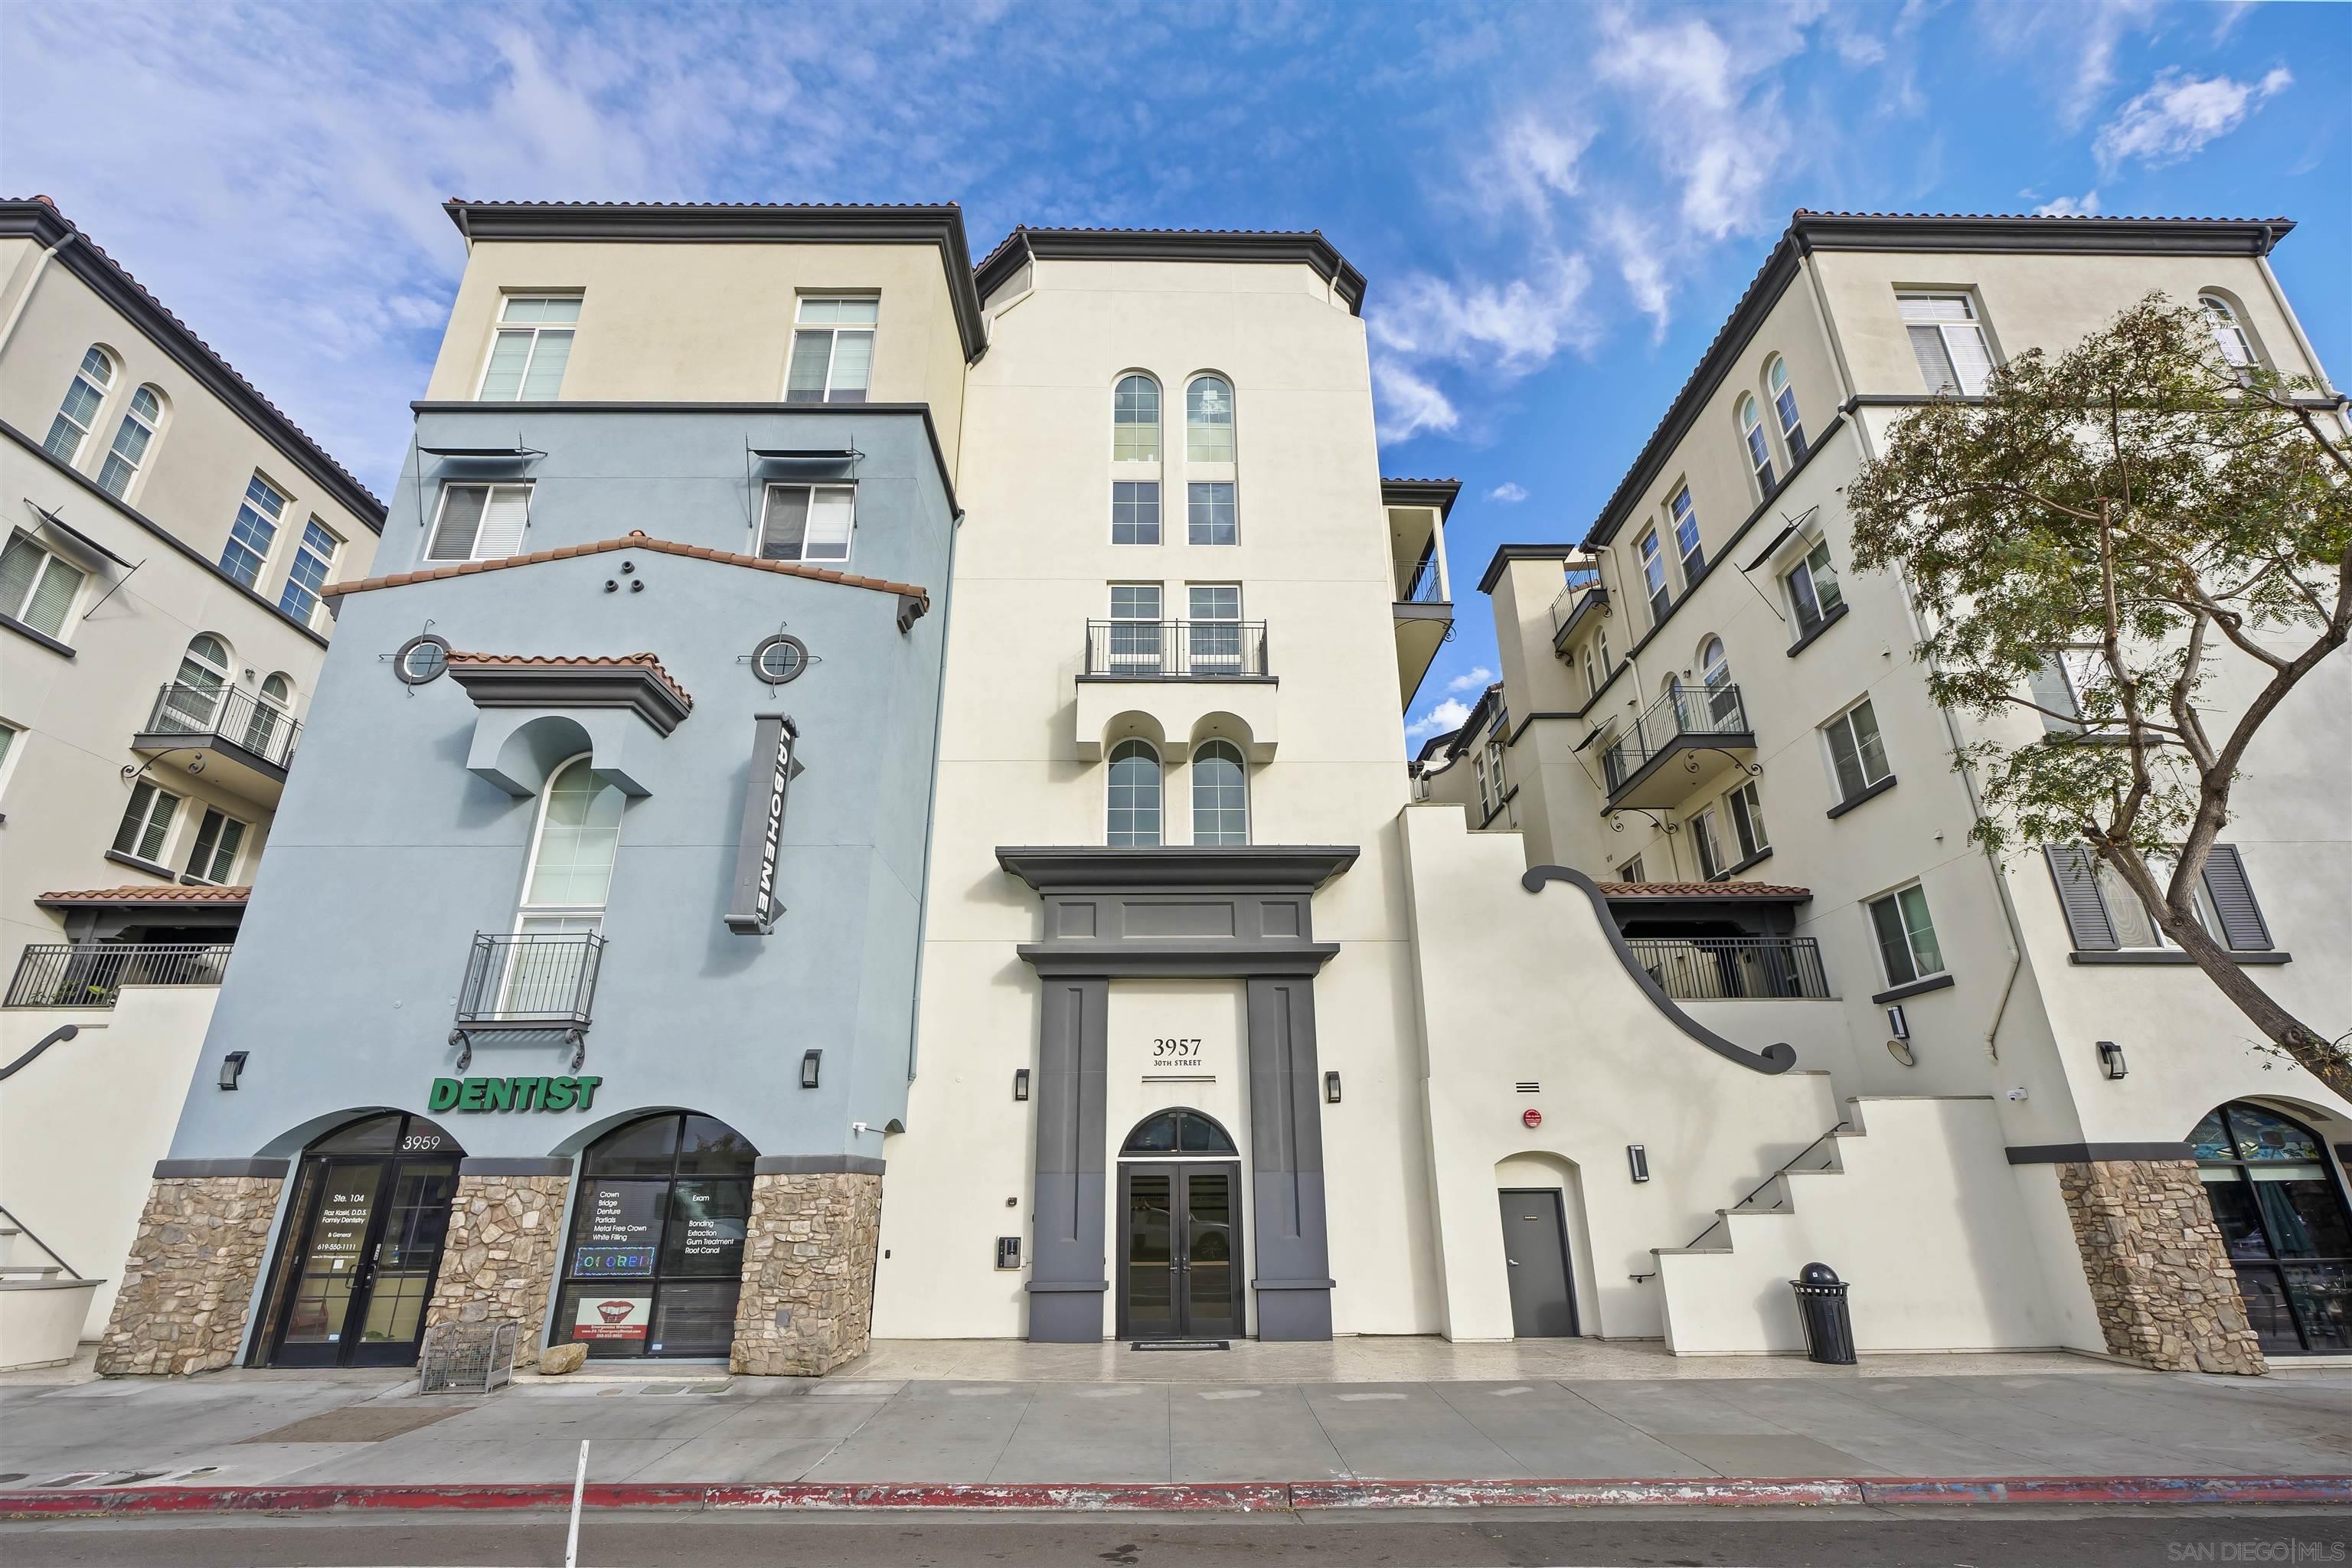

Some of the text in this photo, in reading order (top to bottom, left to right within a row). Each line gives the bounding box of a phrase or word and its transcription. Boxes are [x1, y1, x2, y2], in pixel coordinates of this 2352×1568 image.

[757, 727, 791, 913] LA BOHEME
[1153, 1038, 1202, 1057] 3957
[427, 1076, 603, 1110] DENTIST
[402, 1135, 441, 1150] 3959
[333, 1194, 364, 1203] Ste. 104
[688, 1220, 714, 1228] Bonding
[610, 1233, 628, 1242] Filling
